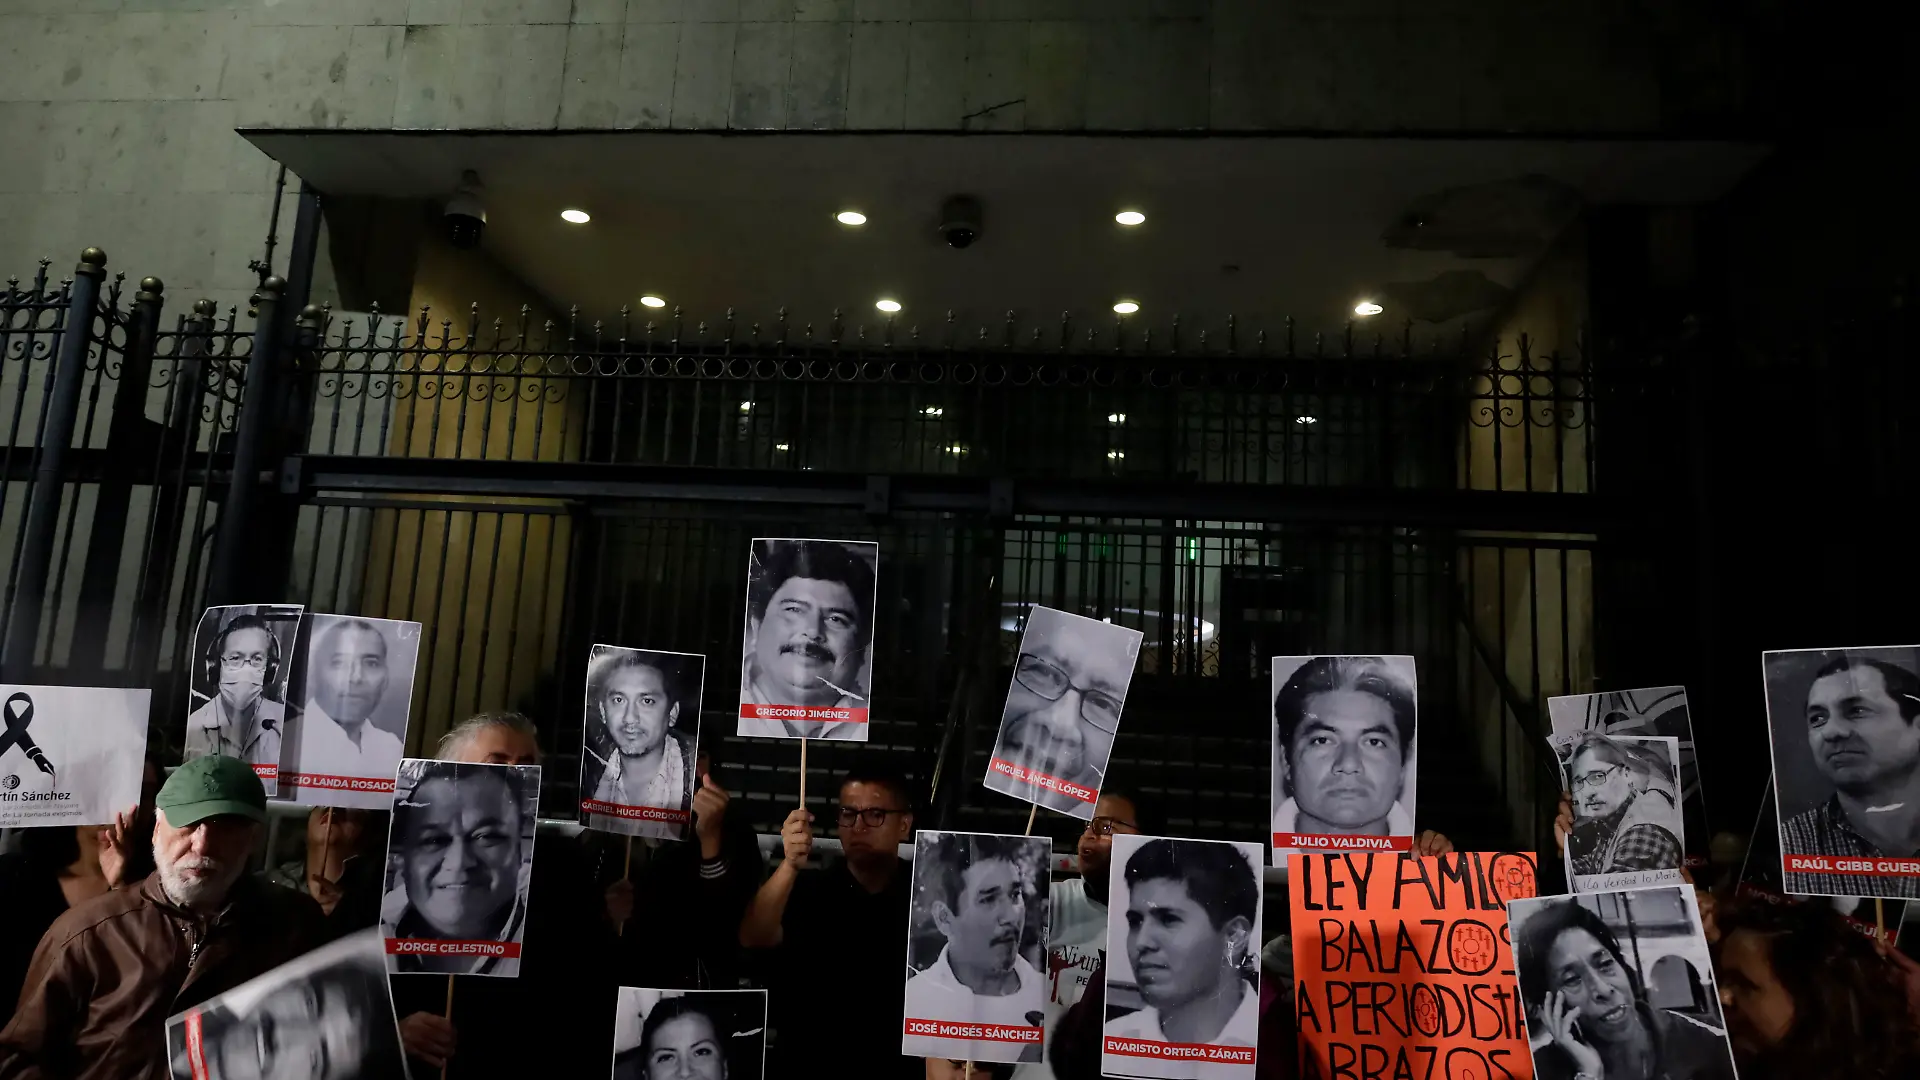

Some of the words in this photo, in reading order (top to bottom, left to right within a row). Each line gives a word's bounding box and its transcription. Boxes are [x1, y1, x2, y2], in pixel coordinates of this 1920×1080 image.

[756, 707, 807, 717] GREGORIO
[808, 709, 850, 719] JIMÉNEZ
[253, 767, 277, 776] ORES
[312, 777, 349, 788] LANDA
[995, 761, 1026, 779] MIGUEL
[1027, 770, 1057, 789] ÁNGEL
[1058, 782, 1091, 800] LÓPEZ
[21, 791, 71, 801] Sánchez
[581, 801, 615, 814] GABRIEL
[616, 807, 641, 817] HUGE
[642, 809, 687, 821] CÓRDOVA
[1290, 835, 1329, 847] JULIO
[1331, 837, 1393, 849] VALDIVIA
[1791, 857, 1834, 870] RAÚL
[1835, 860, 1874, 872] GIBB
[1302, 853, 1374, 911] LEY
[1392, 852, 1538, 912] AMLO
[395, 942, 437, 952] JORGE
[439, 943, 505, 955] CELESTINO
[1075, 975, 1089, 986] PE
[909, 1022, 938, 1034] JOSÉ
[939, 1025, 983, 1037] MOISÉS
[984, 1026, 1040, 1041] SÁNCHEZ
[1107, 1041, 1161, 1055] EVARISTO
[1162, 1046, 1207, 1058] ORTEGA
[1208, 1048, 1252, 1061] ZÁRATE
